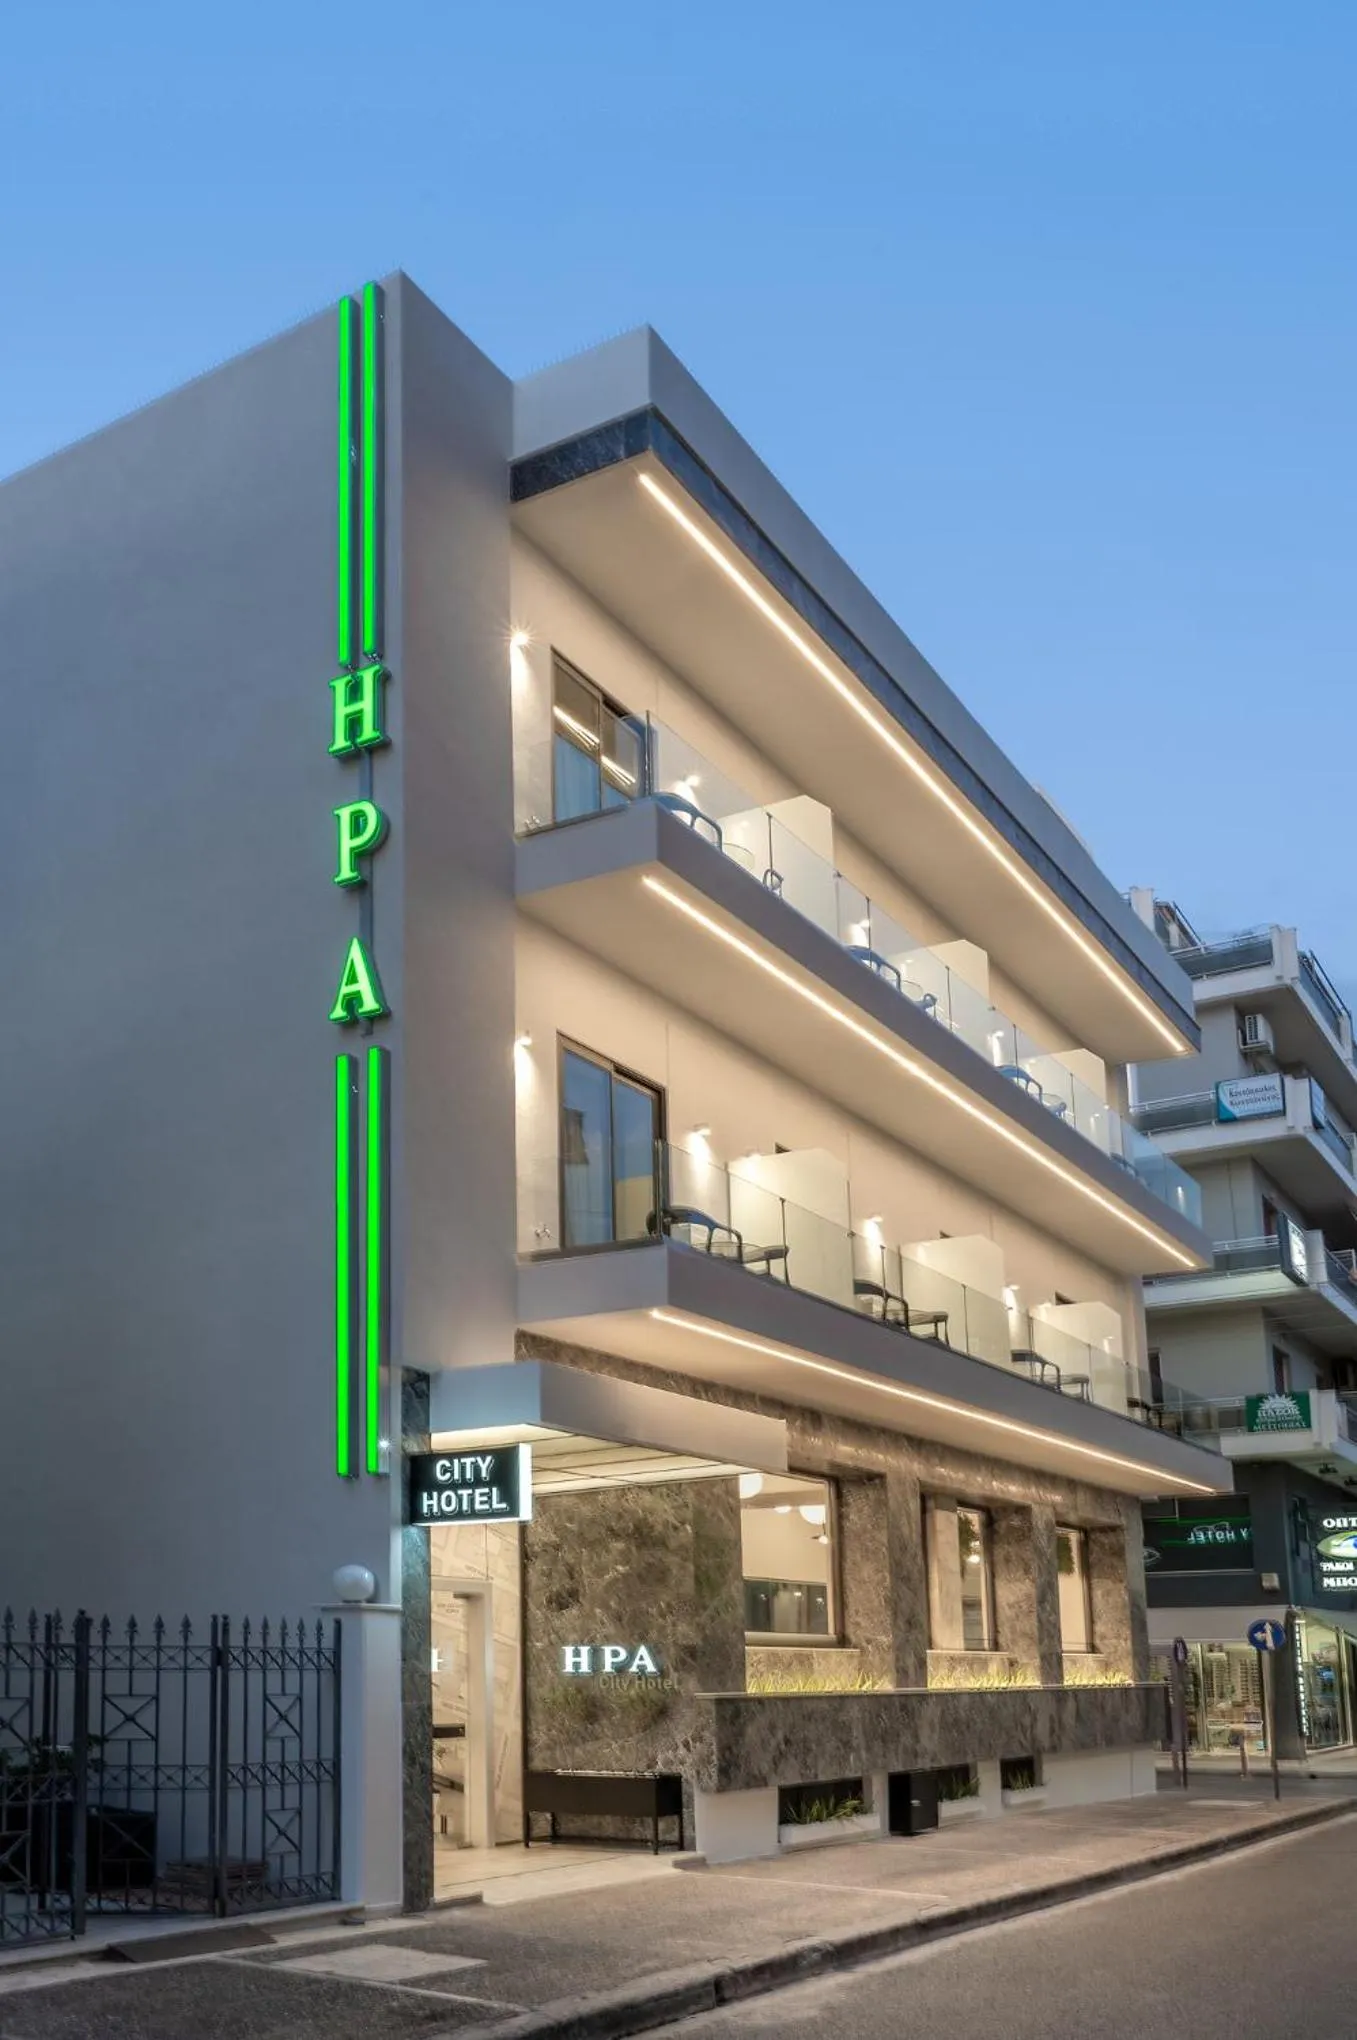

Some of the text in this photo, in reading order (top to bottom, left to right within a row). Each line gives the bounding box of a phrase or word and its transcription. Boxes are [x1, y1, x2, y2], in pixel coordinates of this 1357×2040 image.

[435, 1455, 494, 1483] CITY
[422, 1487, 508, 1515] HOTEL
[561, 1644, 659, 1674] HPA
[599, 1674, 679, 1691] City Hotel
